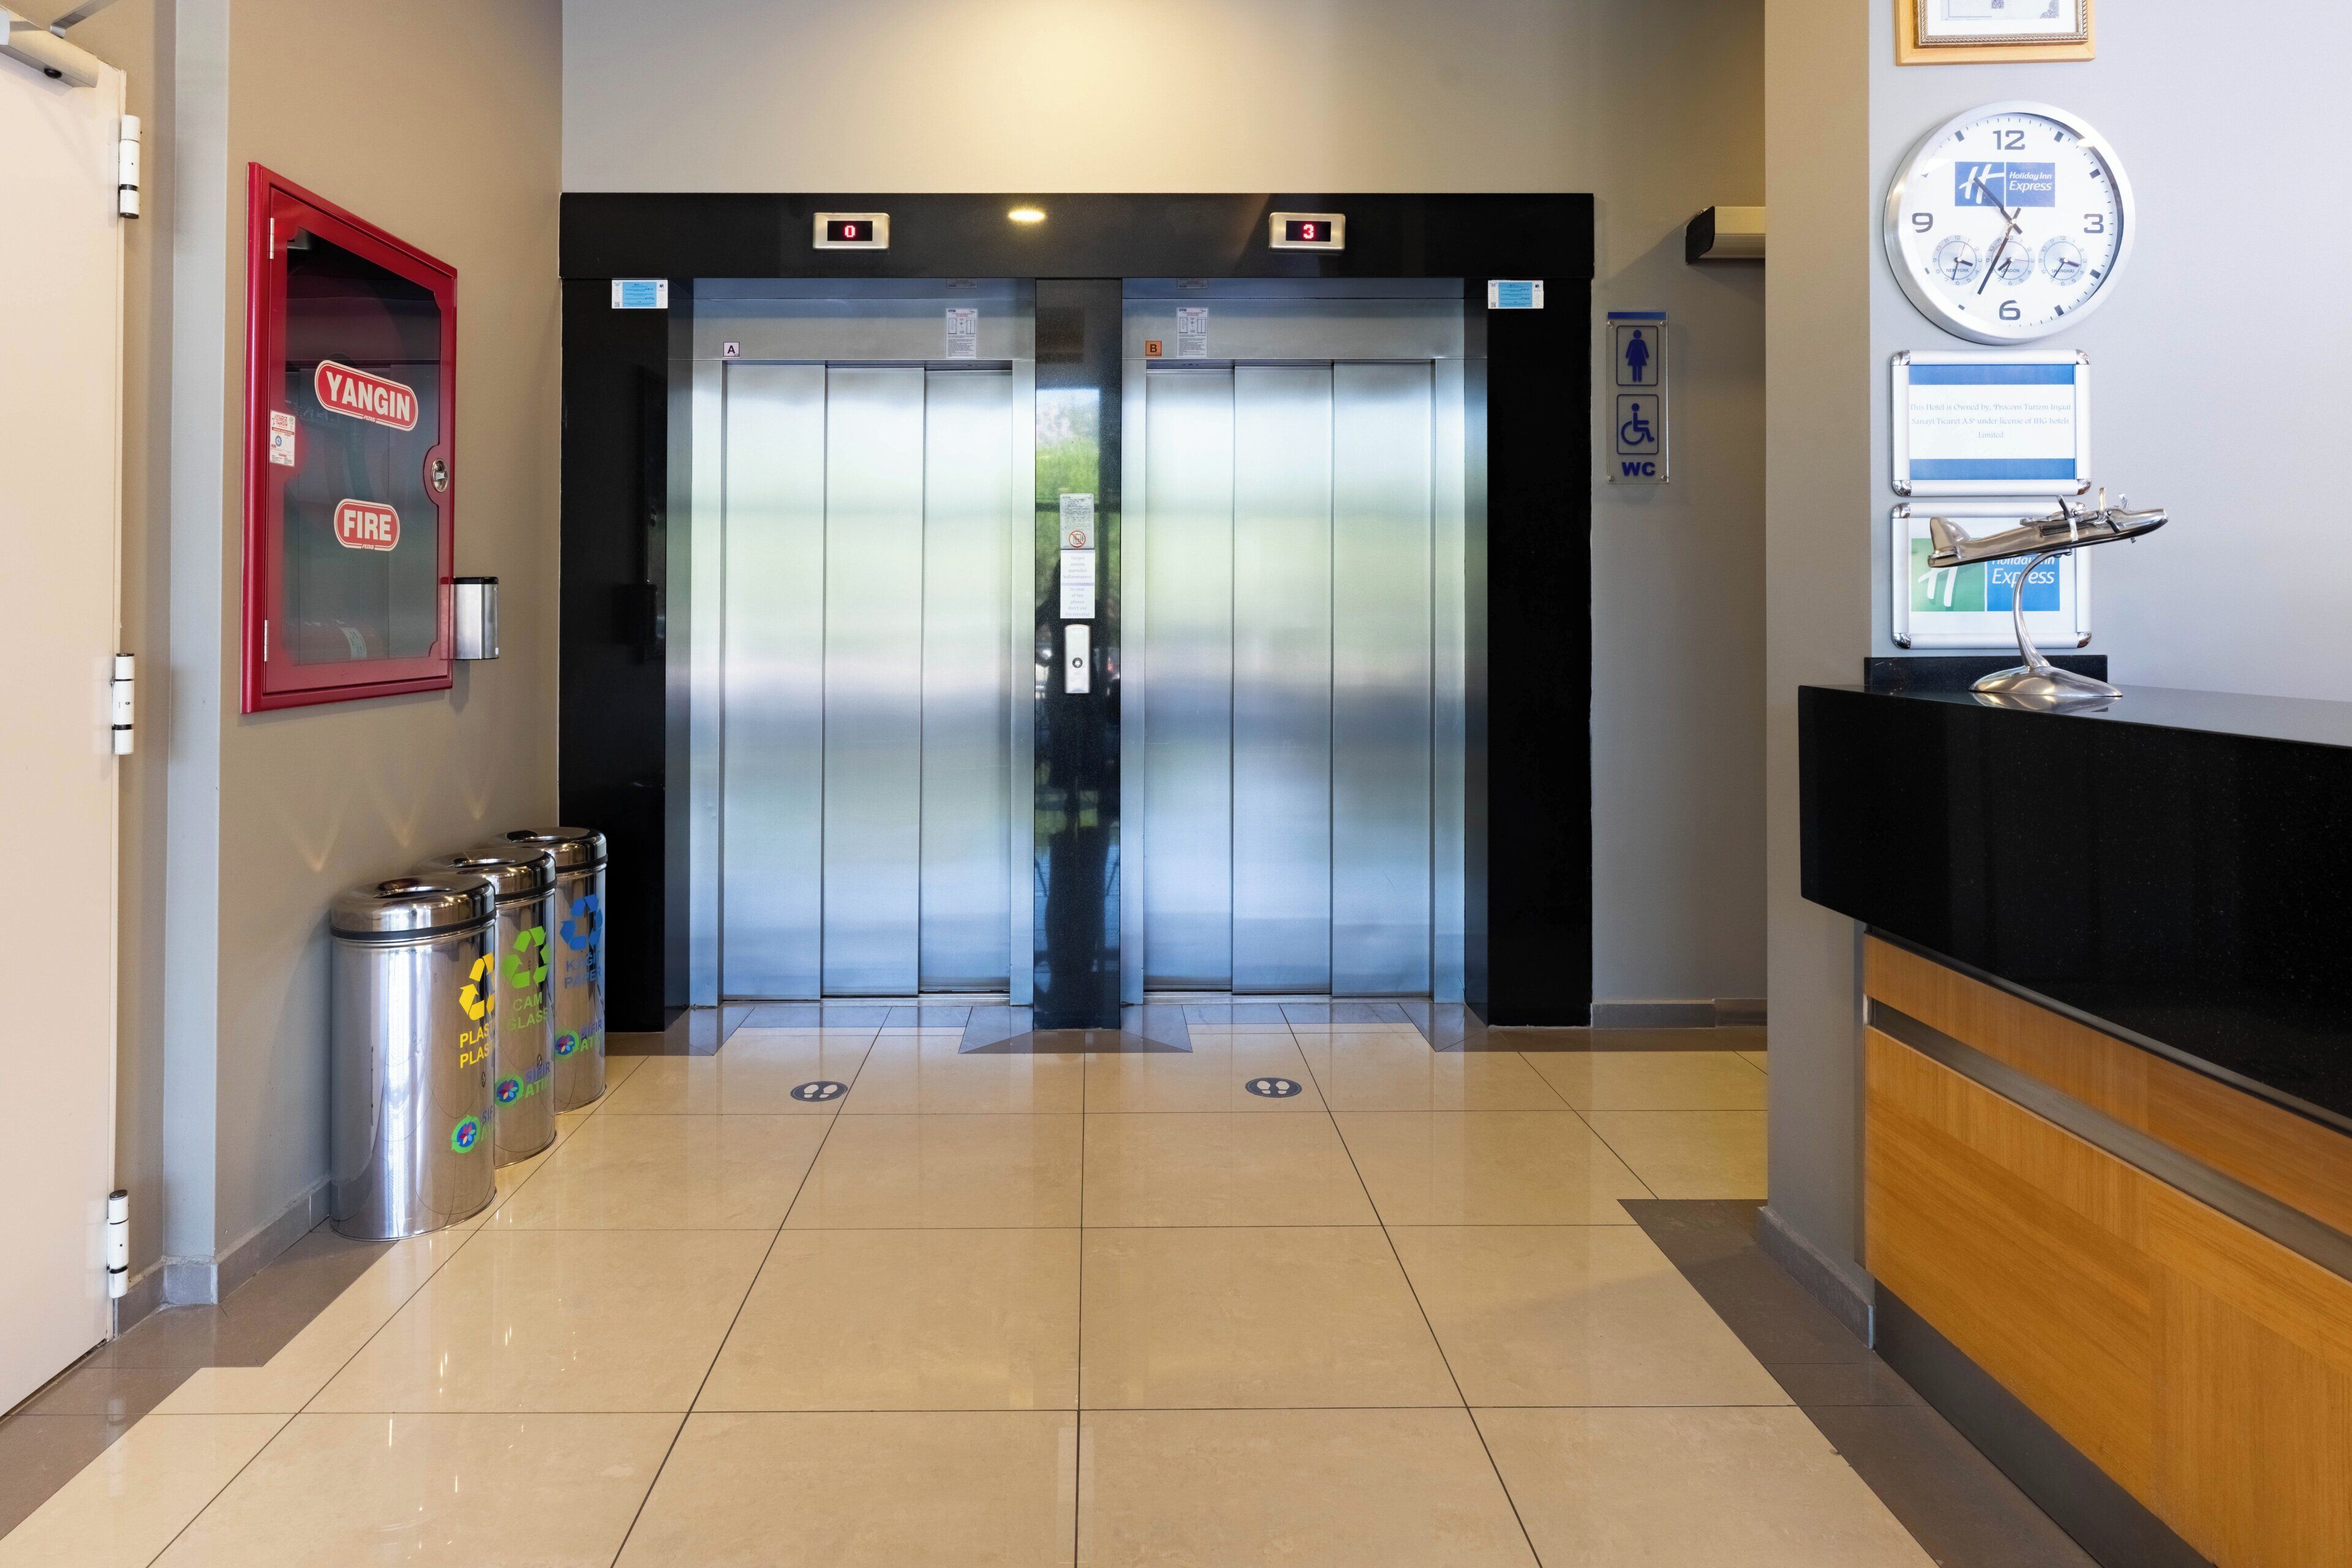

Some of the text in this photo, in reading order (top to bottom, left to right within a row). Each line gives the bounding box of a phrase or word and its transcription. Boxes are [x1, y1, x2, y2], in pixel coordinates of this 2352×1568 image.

[1992, 130, 2026, 150] 12
[2009, 171, 2038, 181] Holiday
[2009, 181, 2052, 193] Express
[845, 225, 856, 238] 0
[1303, 224, 1314, 239] 3
[1912, 213, 1933, 233] 9
[2084, 213, 2104, 233] 3
[1999, 300, 2021, 320] 6
[727, 345, 736, 354] A
[1150, 344, 1158, 353] B
[326, 371, 410, 421] YANGIN
[1621, 462, 1656, 476] WC
[344, 509, 391, 541] FIRE
[1992, 568, 2055, 588] Expess
[513, 992, 543, 1011] CAM
[507, 1006, 549, 1030] GLASS
